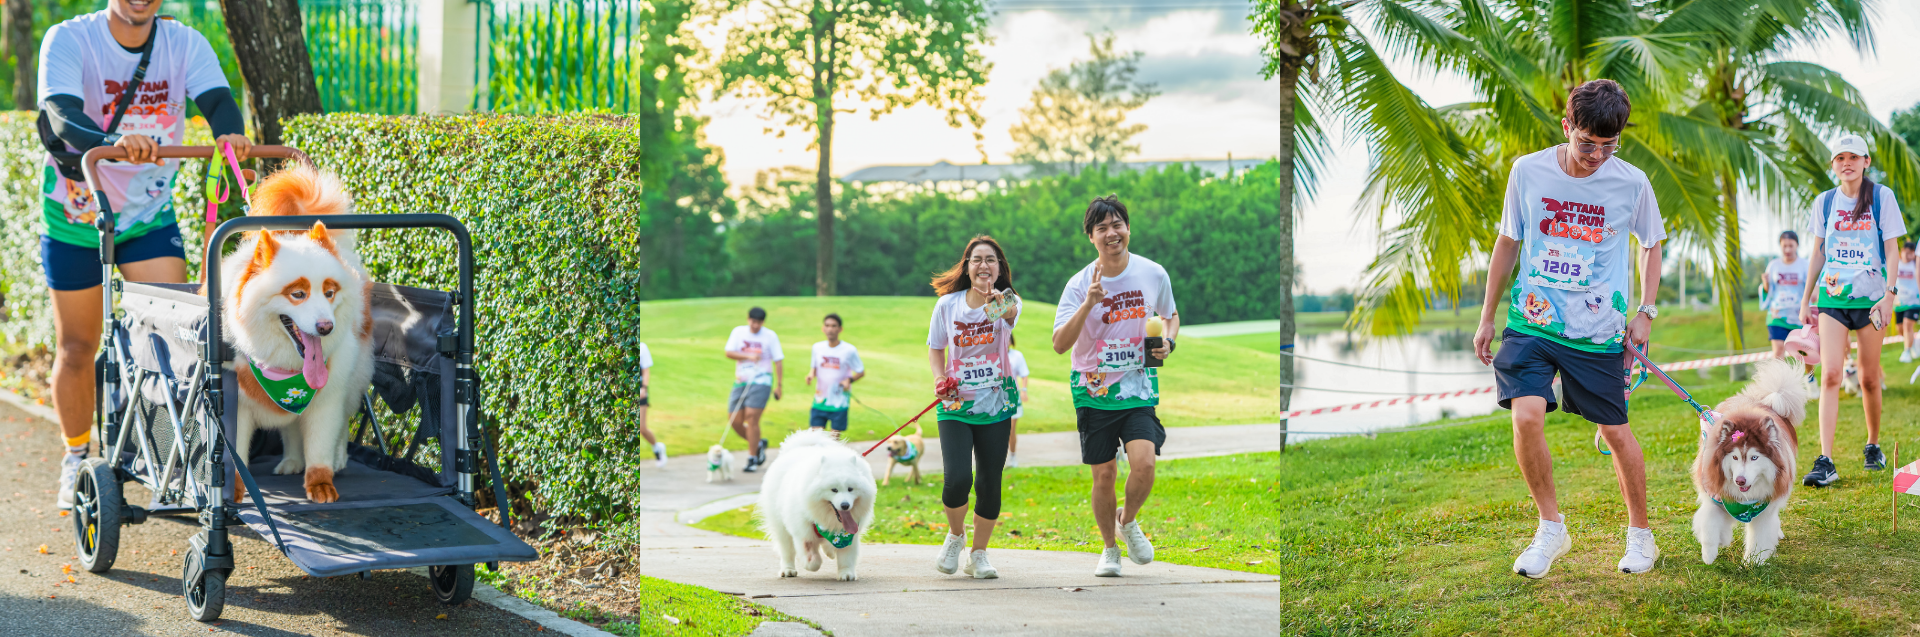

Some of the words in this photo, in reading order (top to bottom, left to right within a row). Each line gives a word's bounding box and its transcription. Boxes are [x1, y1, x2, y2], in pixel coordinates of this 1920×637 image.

[1577, 214, 1605, 228] RUN
[1559, 222, 1604, 244] 2026
[1836, 249, 1865, 259] 1204
[1542, 259, 1582, 277] 1203
[1125, 298, 1145, 308] RUN
[1114, 306, 1146, 322] 2026
[965, 332, 995, 347] 2026
[1105, 350, 1135, 362] 3104
[963, 366, 994, 380] 3103
